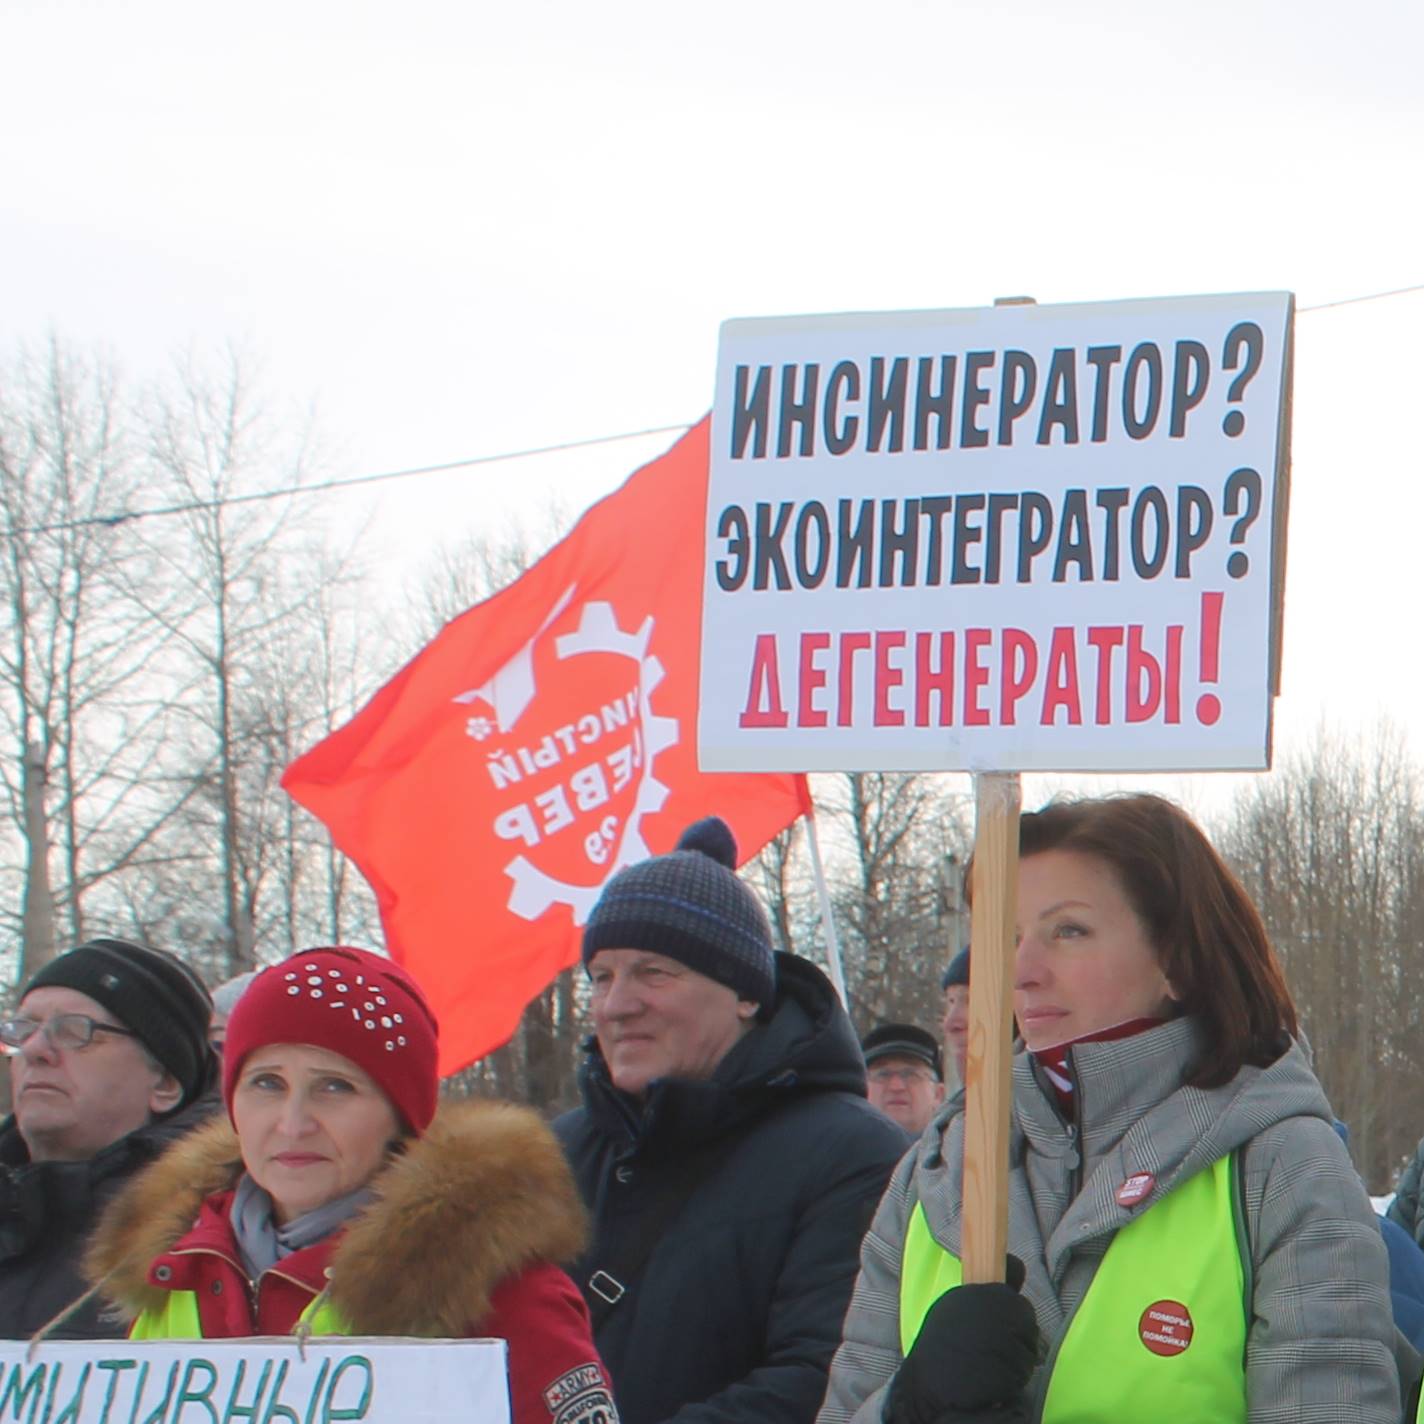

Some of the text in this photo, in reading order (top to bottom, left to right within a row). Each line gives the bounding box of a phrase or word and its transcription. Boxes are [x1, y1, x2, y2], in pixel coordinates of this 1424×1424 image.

[730, 321, 1264, 459] ИНСИНЕРАТОР?
[715, 467, 1262, 592] ЭКОИНТЕГРАТОР?
[738, 590, 1224, 728] ДЕГЕНЕРАТЫ!
